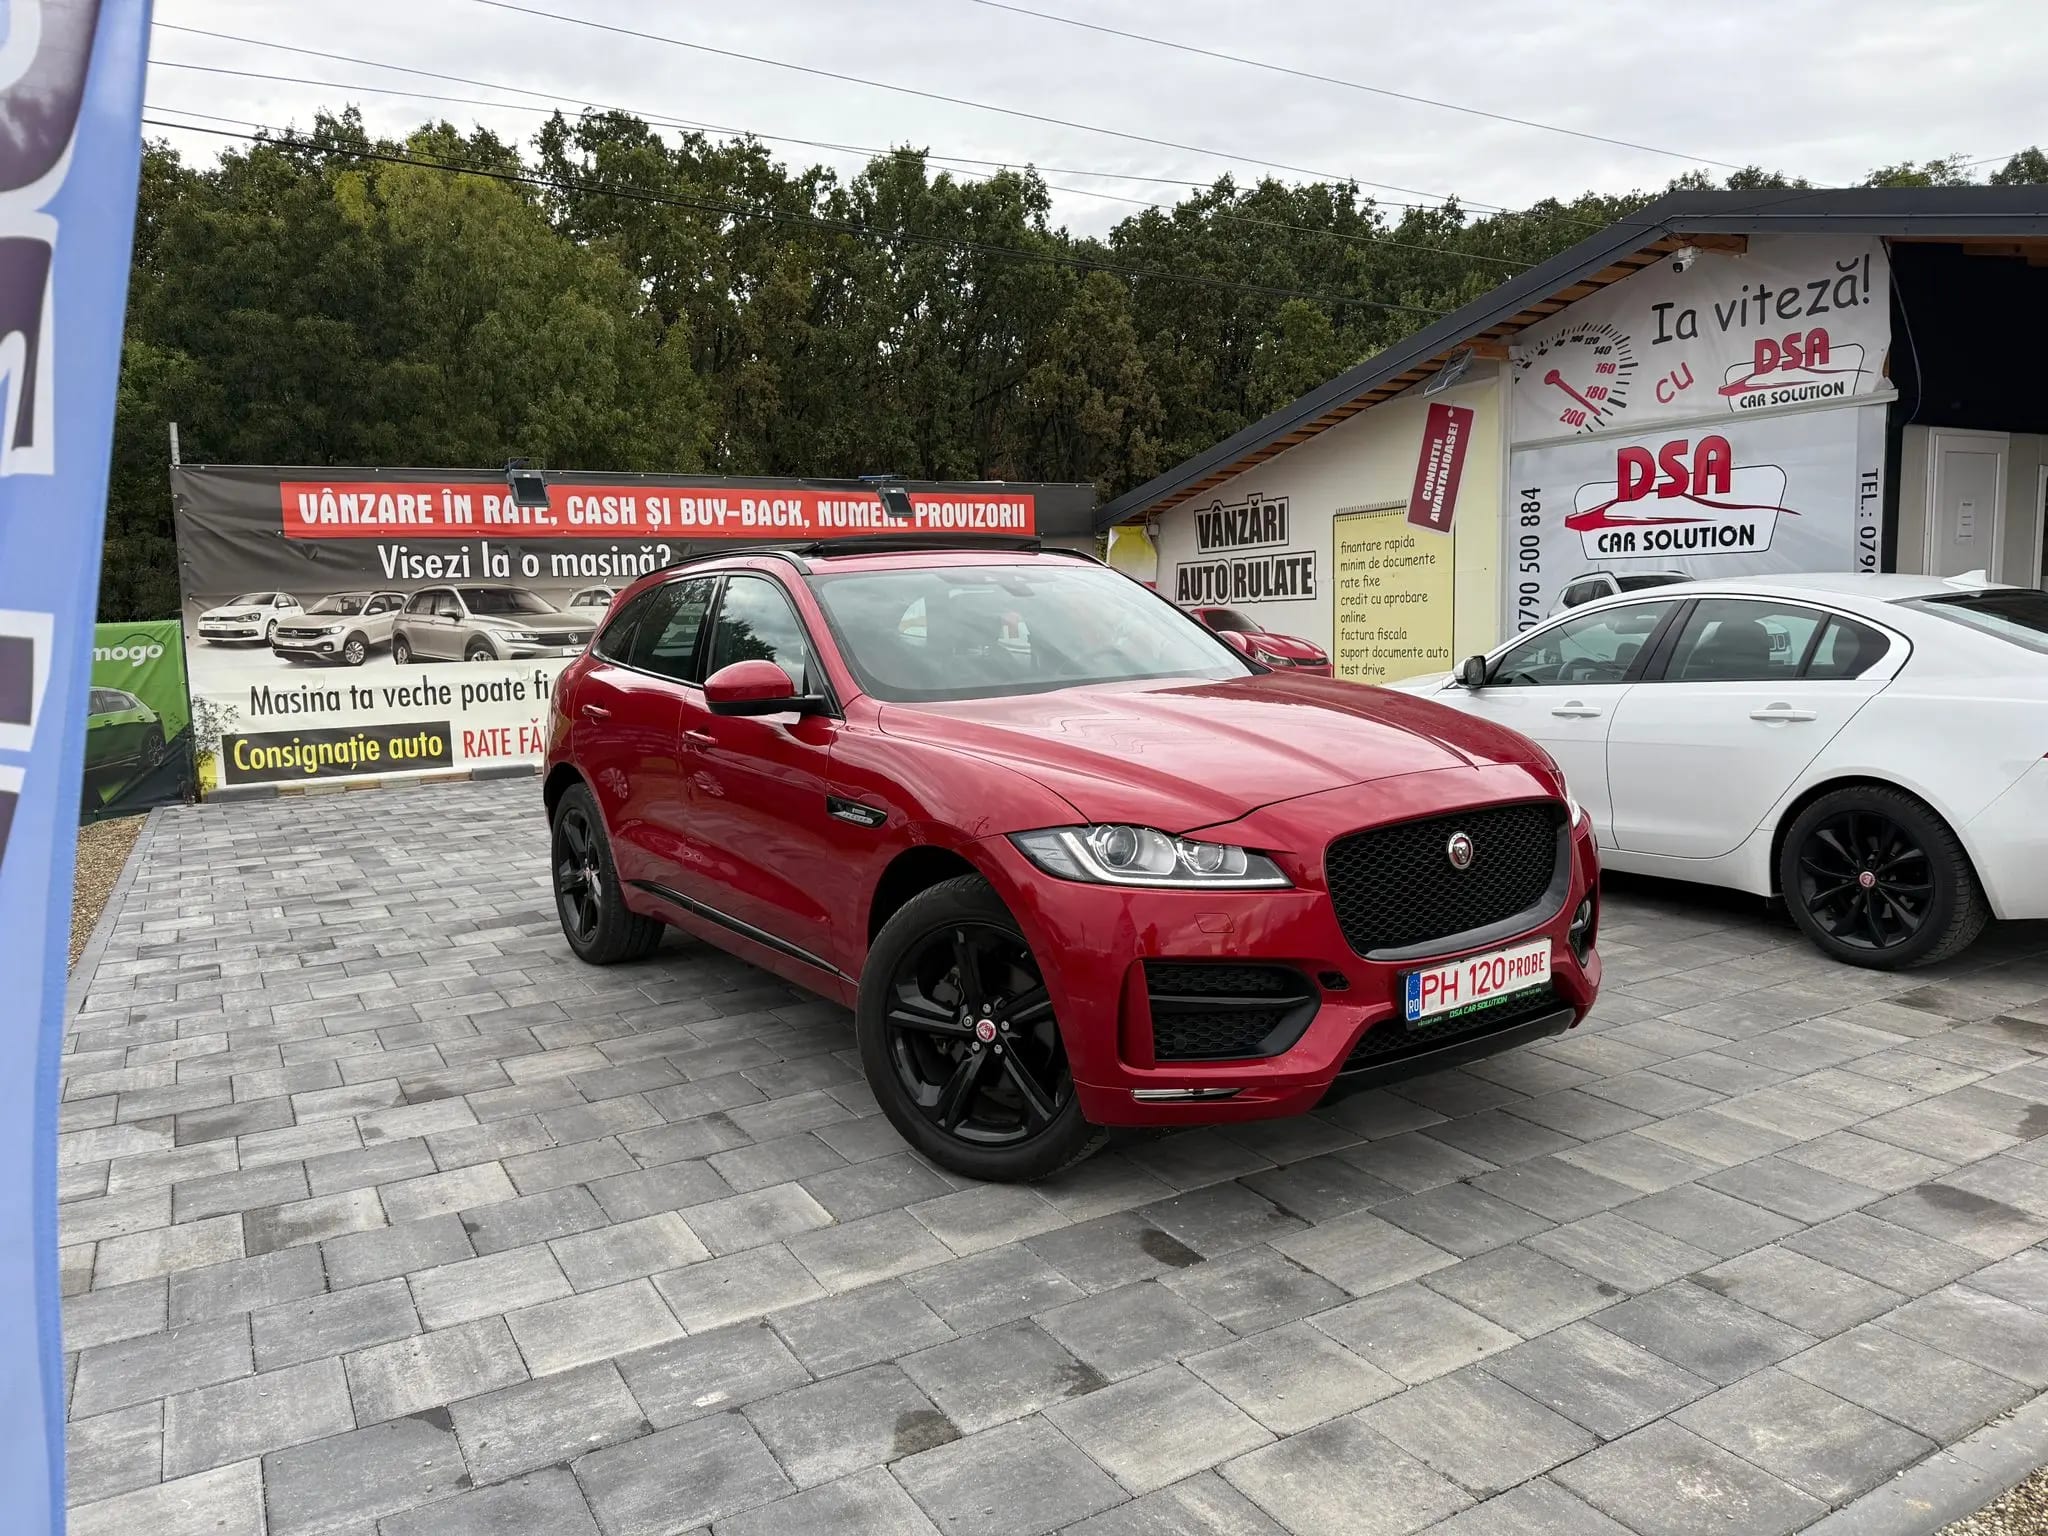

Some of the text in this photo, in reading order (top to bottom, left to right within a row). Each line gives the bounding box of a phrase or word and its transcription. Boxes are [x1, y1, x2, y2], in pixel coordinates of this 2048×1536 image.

[1651, 253, 1871, 345] Ia viteză!
[1593, 345, 1613, 355] 140
[1754, 327, 1830, 376] DSA
[1595, 362, 1616, 375] 160
[1656, 361, 1695, 404] cu
[1585, 385, 1609, 401] 180
[1739, 381, 1845, 409] CAR SOLUTION
[1559, 407, 1587, 427] 200
[1430, 422, 1459, 523] AVANTAJOASE!
[1617, 435, 1732, 502] DSA
[298, 487, 434, 525] VÂNZARE
[441, 487, 476, 525] ÎN
[567, 496, 637, 525] CASH
[680, 497, 810, 529] BUY-BACK,
[915, 502, 1026, 529] PROVIZORII
[1197, 500, 1286, 549] VÂNZĂRI
[1340, 534, 1415, 555] finantare rapida
[1597, 524, 1755, 553] CAR SOLUTION
[1859, 525, 1877, 573] 079
[376, 544, 471, 581] Visezi
[482, 541, 511, 579] la
[520, 554, 541, 577] o
[1340, 552, 1436, 572] minim de documente
[1517, 487, 1541, 633] 0790 500 884
[1177, 557, 1313, 601] AUTO RULATE
[1340, 574, 1381, 589] rate fixe
[1340, 590, 1429, 608] credit cu aprobare
[1340, 610, 1367, 623] online
[1340, 627, 1408, 641] factura fiscala
[1340, 645, 1450, 661] suport documente auto
[1340, 663, 1386, 676] test drive
[250, 669, 549, 716] Masina ta veche poate fi
[233, 731, 444, 774] Consignație auto
[462, 717, 546, 759] RATE FĂ
[1408, 950, 1546, 1014] RO PH 120 PROBE
[1449, 995, 1508, 1018] DSA CAR SOLUTION
